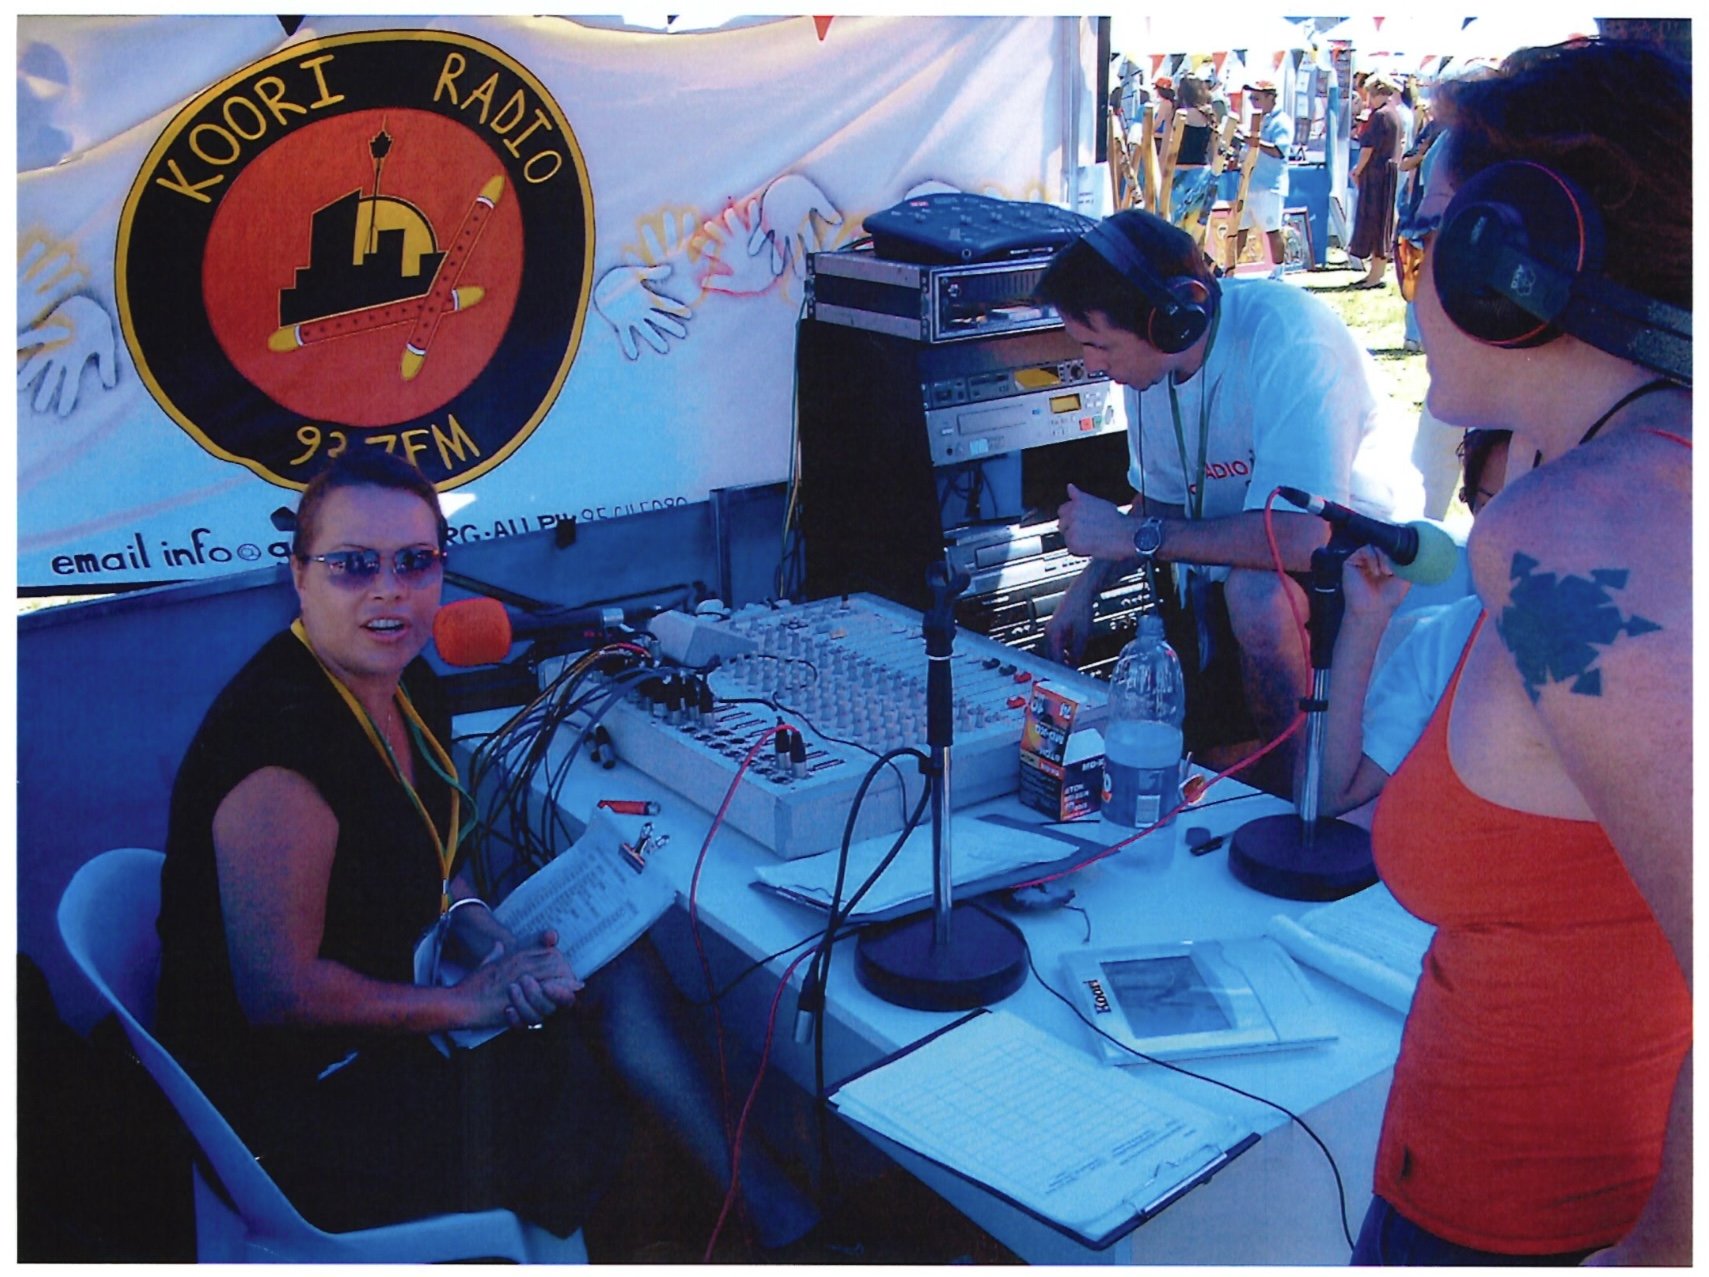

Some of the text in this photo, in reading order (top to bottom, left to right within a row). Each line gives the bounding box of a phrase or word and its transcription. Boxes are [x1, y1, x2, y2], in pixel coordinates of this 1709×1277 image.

[156, 52, 562, 203] KOORI RADIO
[51, 532, 151, 575] email
